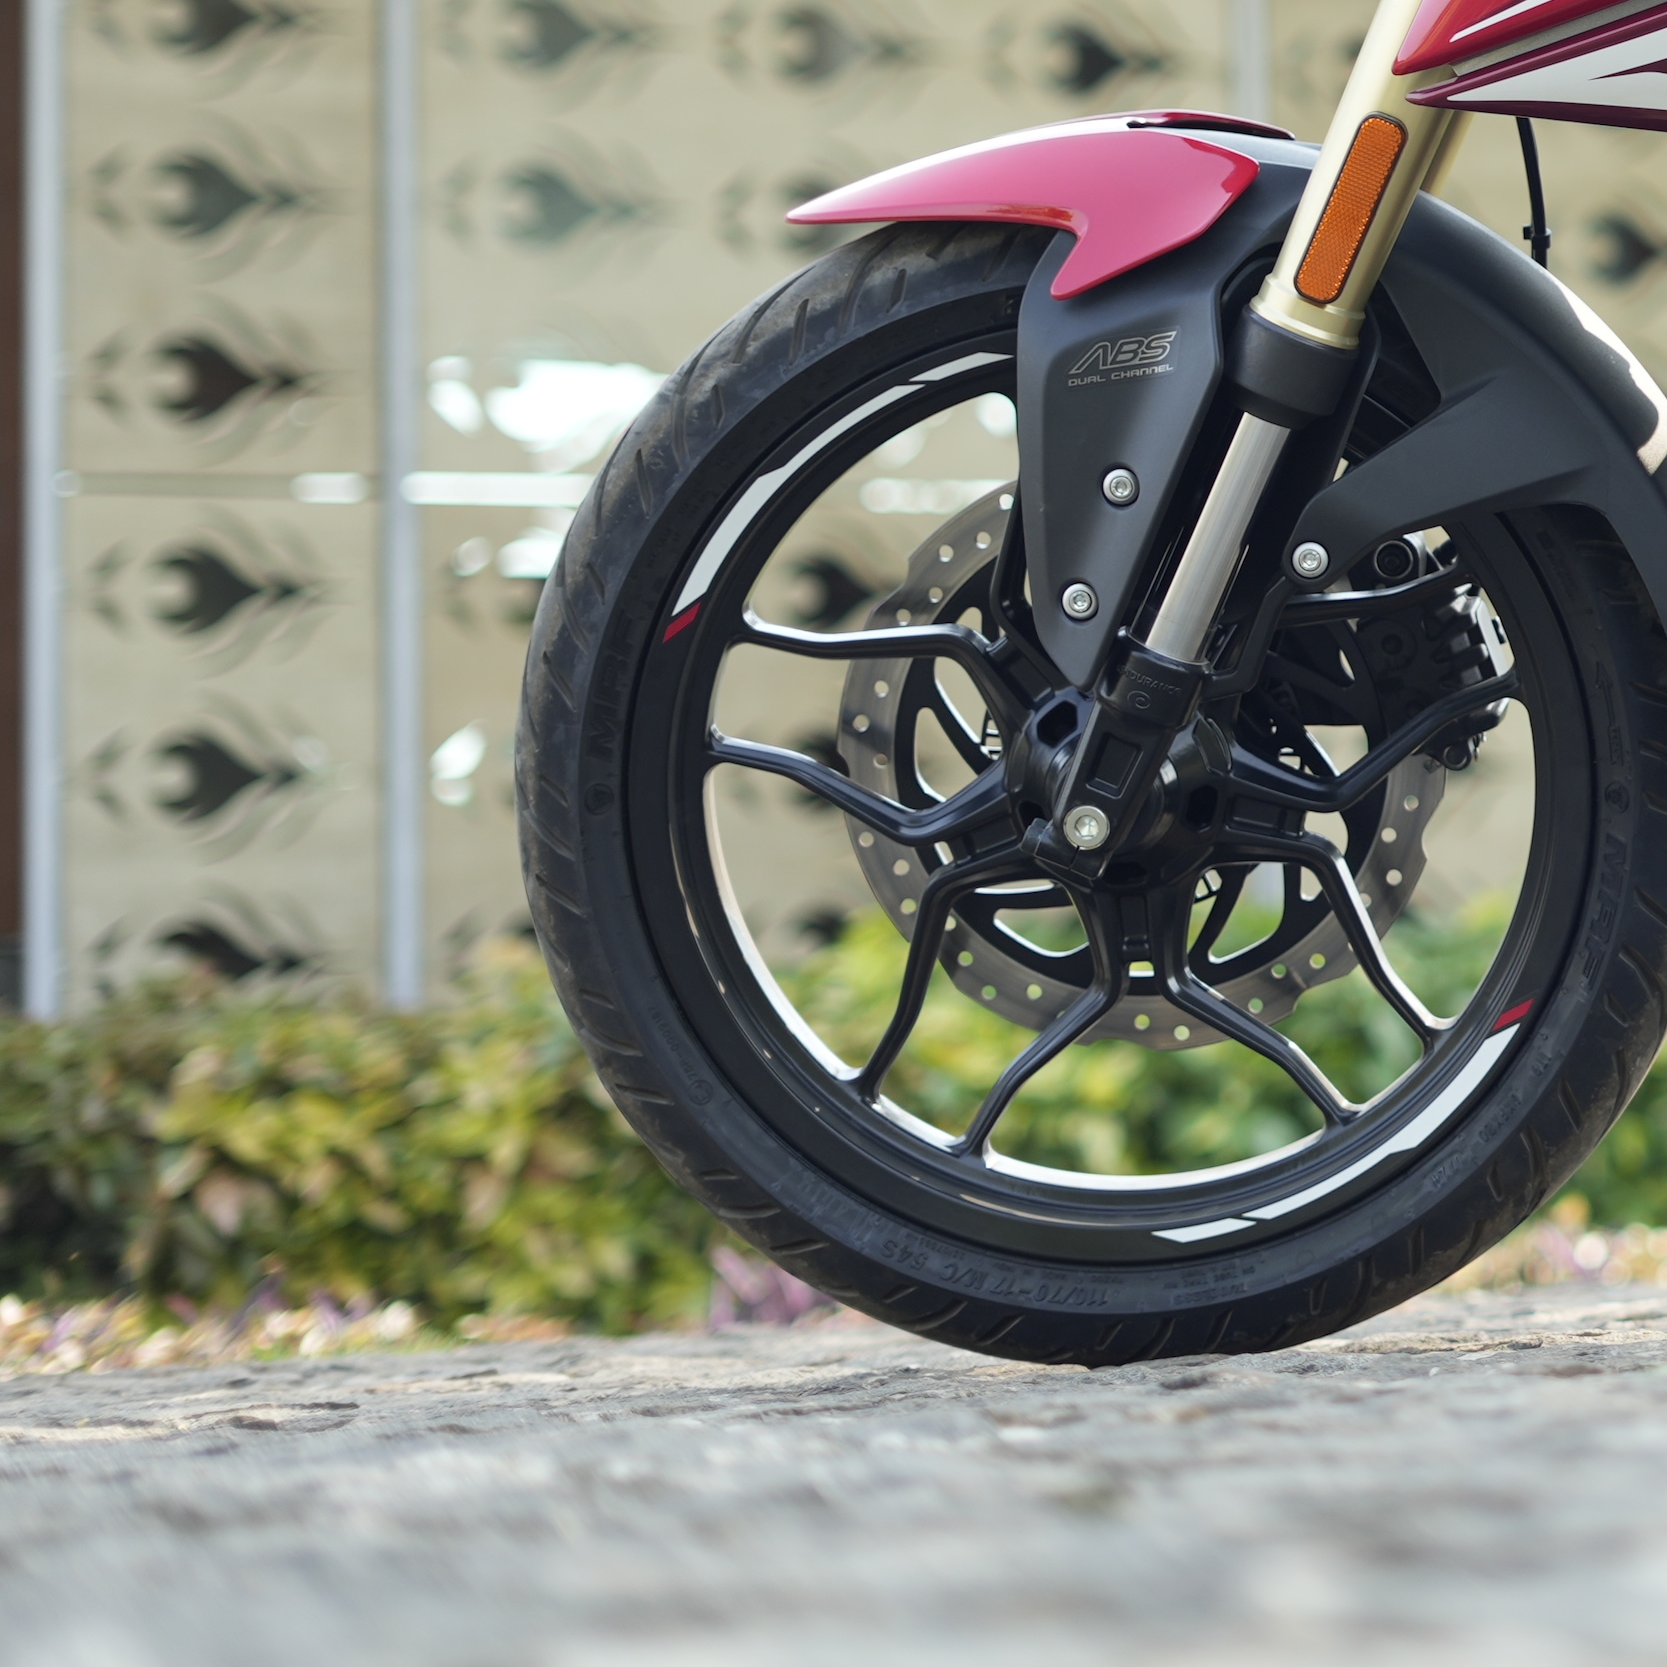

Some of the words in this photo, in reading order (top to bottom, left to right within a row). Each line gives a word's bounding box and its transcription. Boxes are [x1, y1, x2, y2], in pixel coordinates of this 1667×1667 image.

[1068, 330, 1177, 374] ABS
[1068, 374, 1106, 386] DUAL
[1111, 363, 1174, 380] CHANNEL
[1581, 832, 1628, 991] MRF
[879, 1238, 929, 1272] 54S
[938, 1261, 989, 1292] M/C
